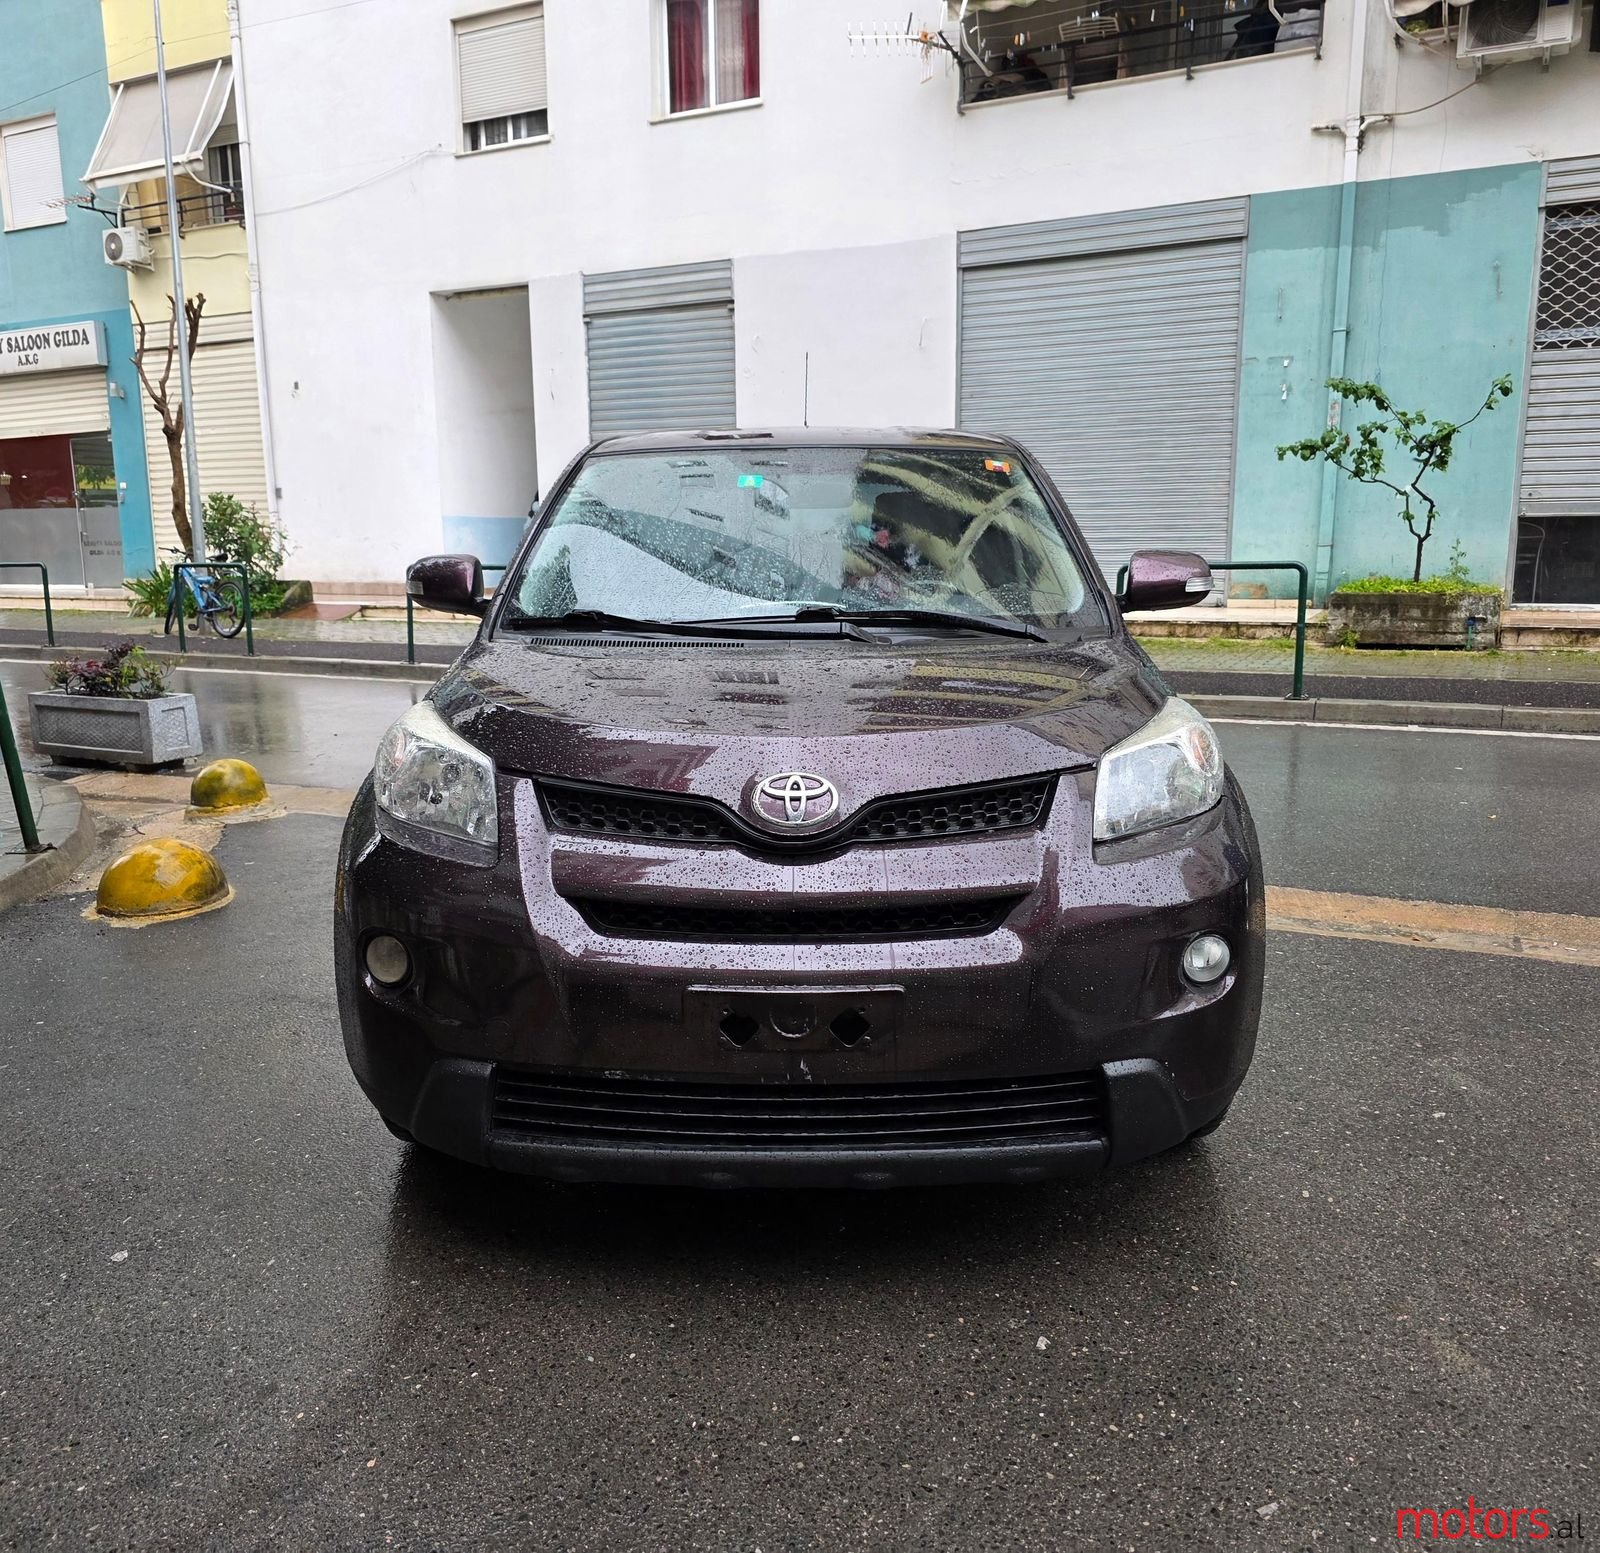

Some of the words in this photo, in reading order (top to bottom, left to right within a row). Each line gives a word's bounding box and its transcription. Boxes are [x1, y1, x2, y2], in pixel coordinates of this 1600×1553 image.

[7, 333, 51, 353] SALOON
[54, 328, 90, 348] GILDA
[18, 353, 39, 367] A.K.G
